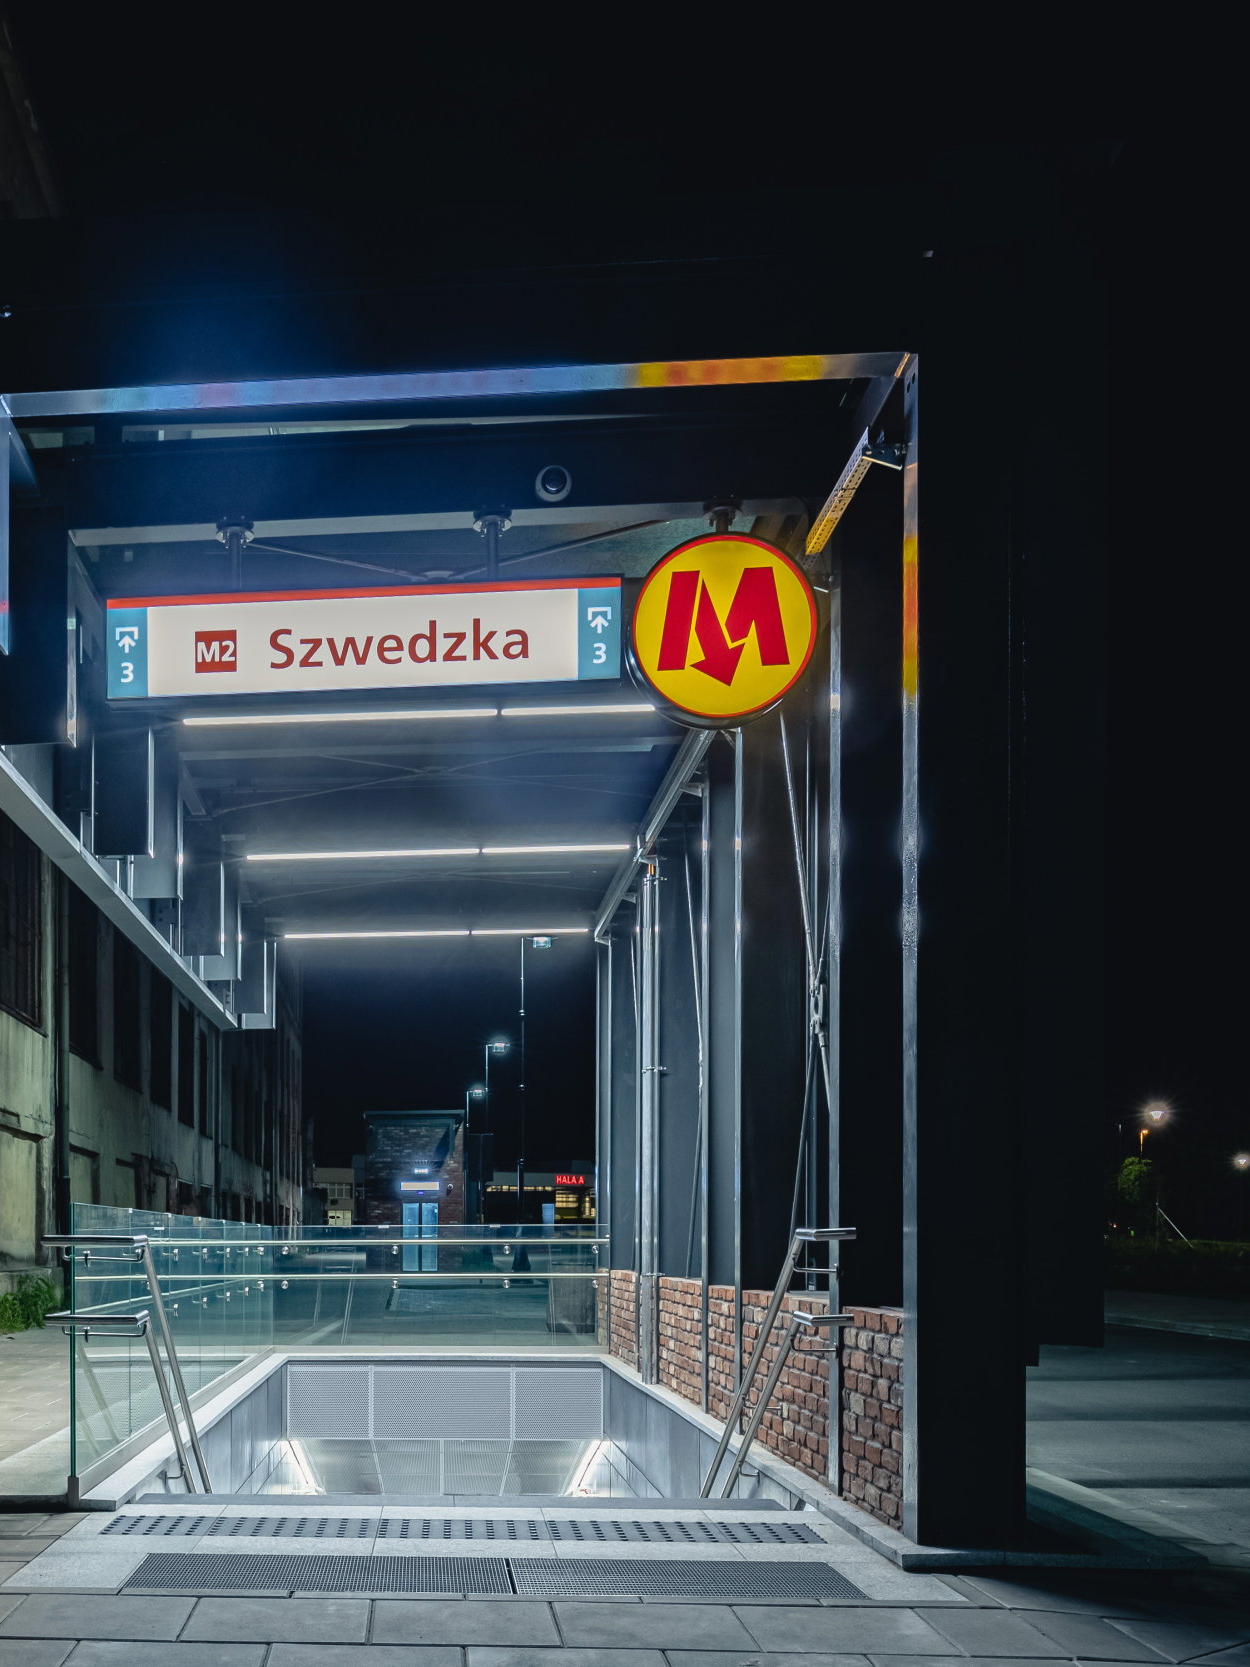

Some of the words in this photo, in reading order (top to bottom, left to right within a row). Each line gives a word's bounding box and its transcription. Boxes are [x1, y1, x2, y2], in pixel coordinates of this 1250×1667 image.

[197, 640, 236, 663] M2
[269, 618, 530, 669] Szwedzka
[592, 642, 607, 665] 3
[120, 661, 134, 683] 3
[556, 1175, 577, 1184] HALA
[578, 1175, 584, 1184] A
